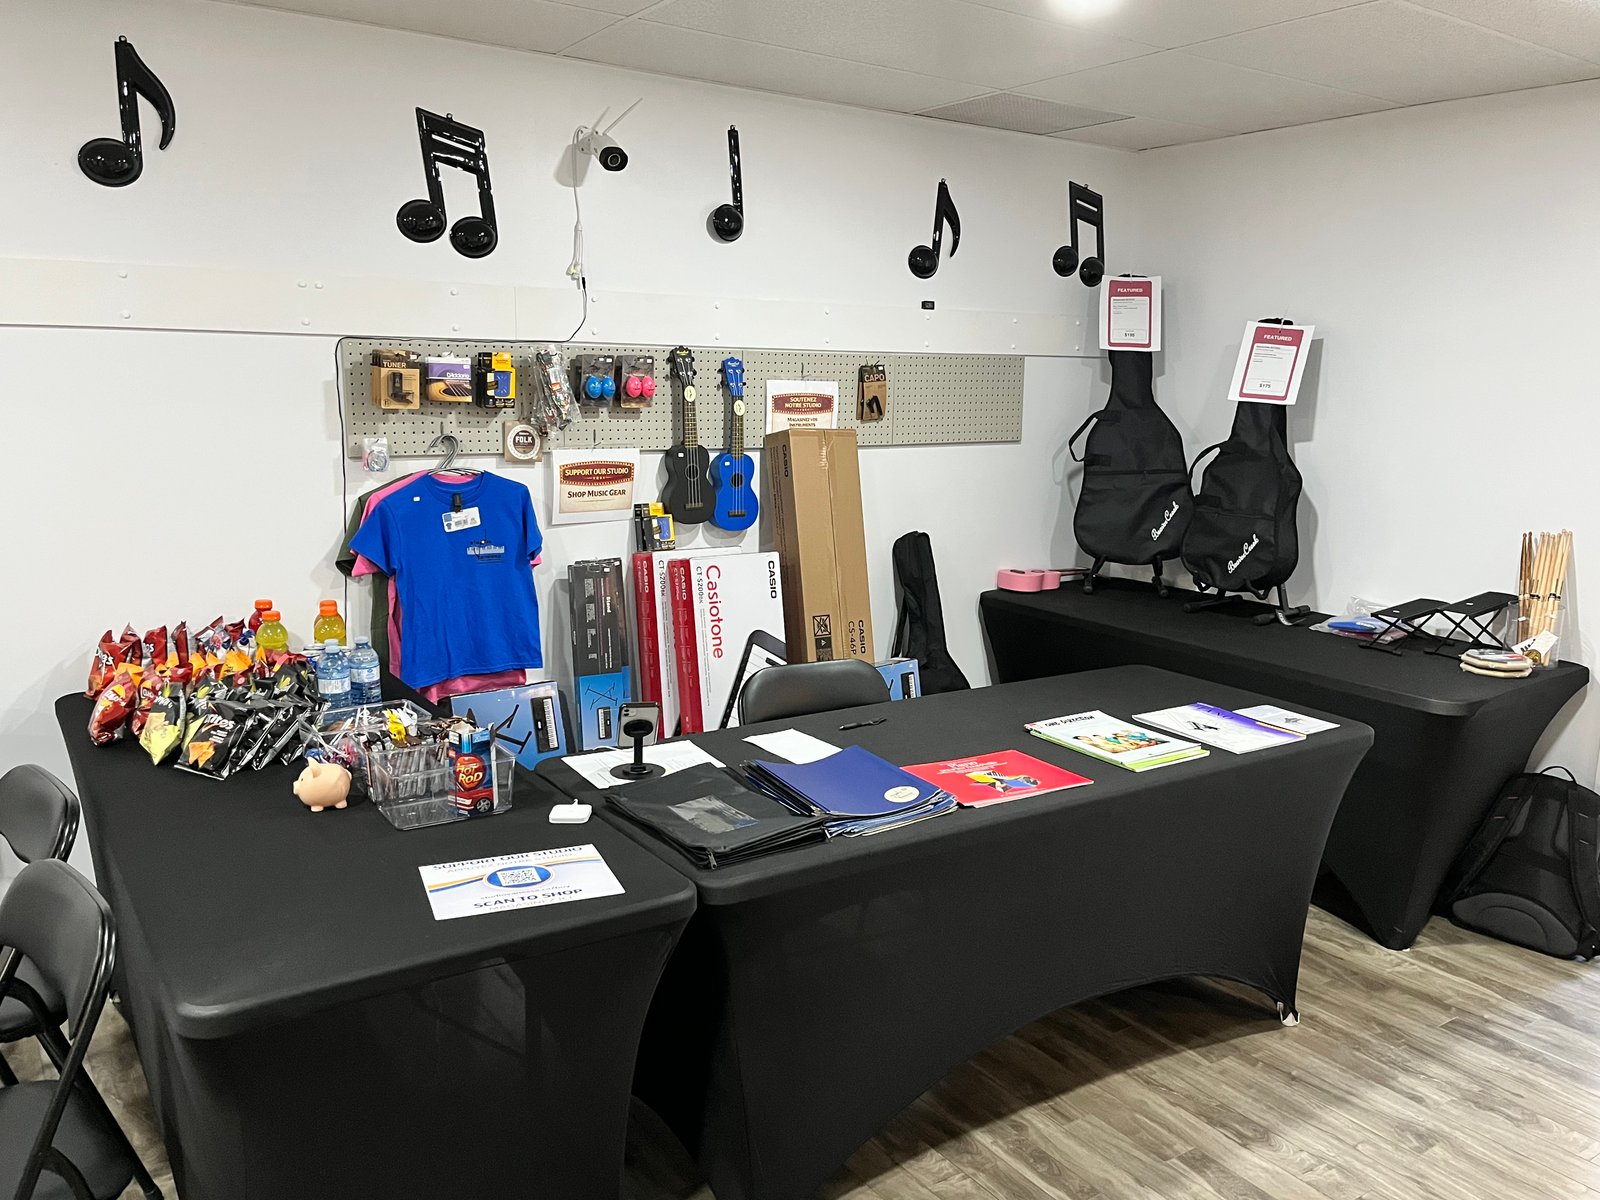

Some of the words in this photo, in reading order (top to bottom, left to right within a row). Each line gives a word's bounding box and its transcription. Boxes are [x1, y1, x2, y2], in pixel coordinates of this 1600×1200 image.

[1263, 334, 1293, 342] FEATURED
[864, 373, 886, 382] CAPO
[515, 435, 533, 444] FOLK
[564, 468, 593, 477] SUPPORT
[593, 468, 607, 476] OUR
[606, 467, 630, 475] STUDIO
[781, 444, 789, 478] CASIO
[642, 560, 650, 593] CASIO
[679, 566, 687, 601] CASIO
[767, 560, 778, 600] CASIO
[705, 564, 724, 659] Casiotone
[848, 620, 857, 655] CS-46P
[858, 619, 866, 654] CASIO
[456, 762, 480, 776] HOT
[433, 858, 496, 871] SUPPORT
[533, 847, 582, 856] STUDIO
[473, 898, 515, 908] SCAN
[517, 893, 538, 904] TO
[541, 888, 583, 899] SHOP
